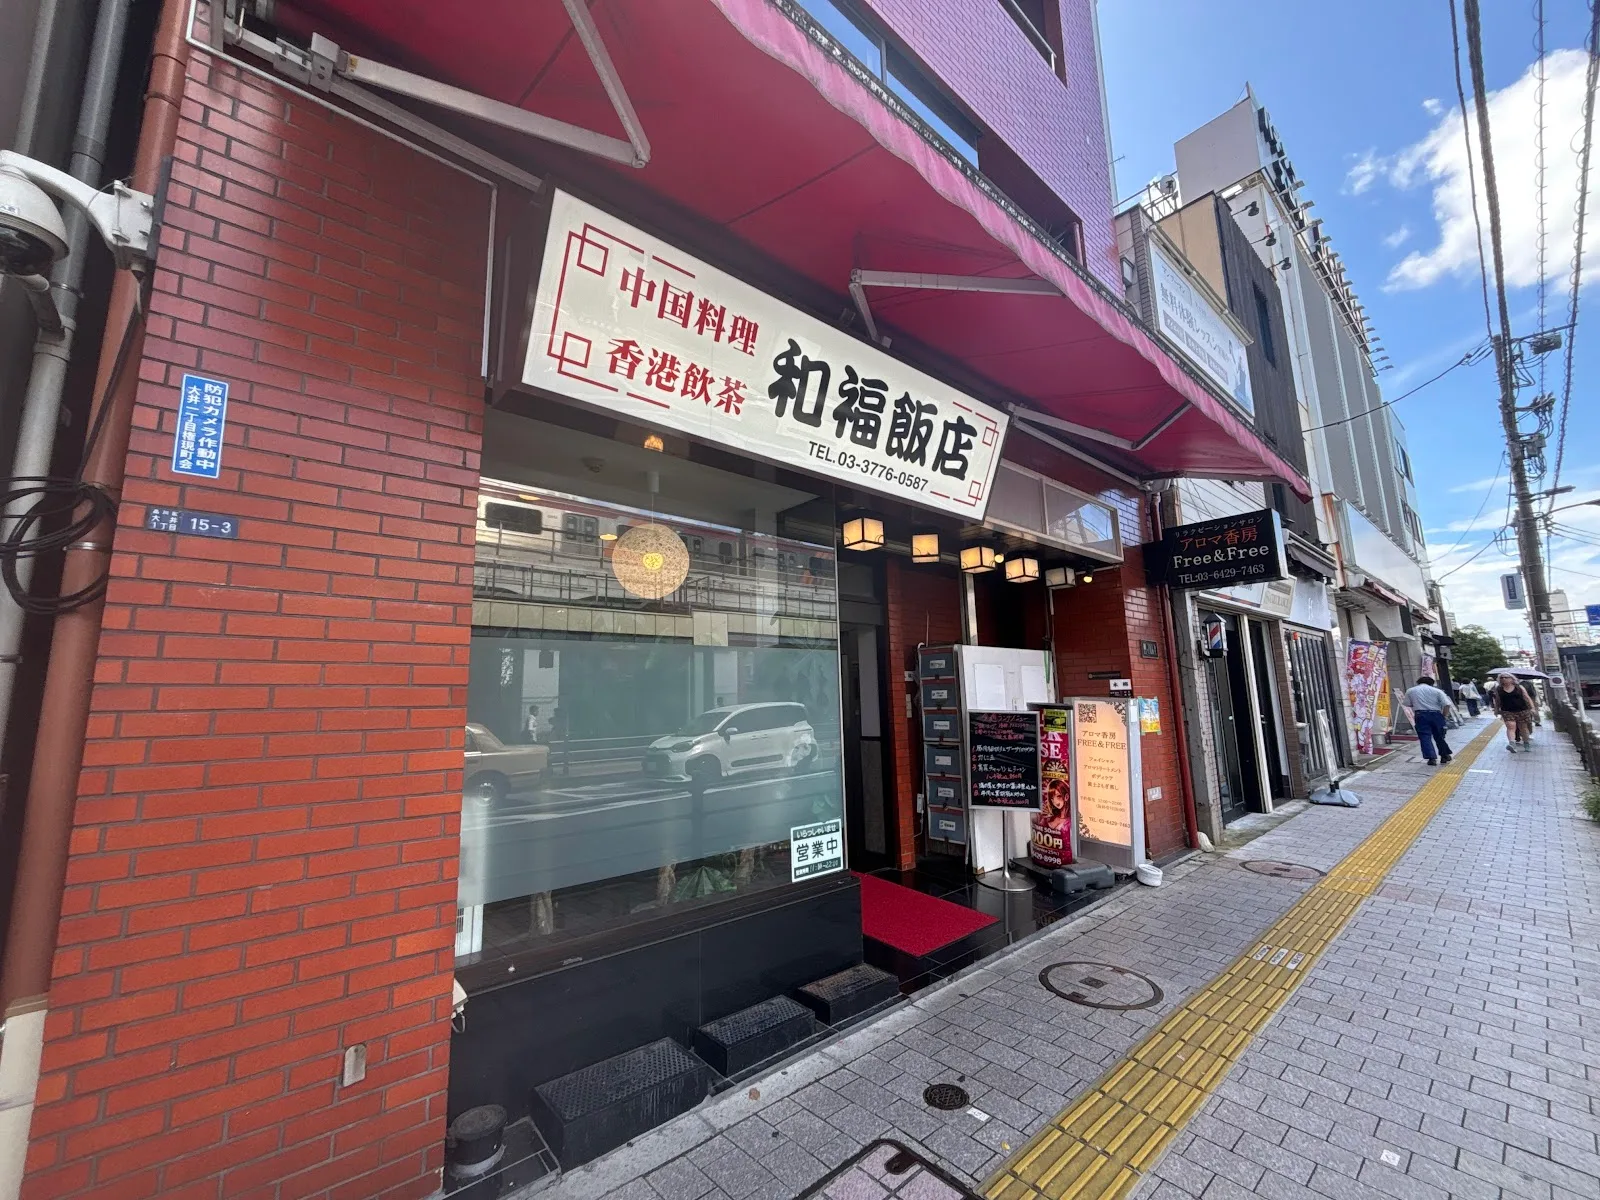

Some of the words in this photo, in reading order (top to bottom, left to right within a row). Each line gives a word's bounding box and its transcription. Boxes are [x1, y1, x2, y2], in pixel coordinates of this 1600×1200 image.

[619, 265, 760, 358] 中国料理
[605, 337, 748, 416] 香港飲茶
[767, 337, 979, 482] 和福飯店
[178, 384, 202, 470] 大井一丁目権現町会
[196, 382, 223, 470] 防犯カメラ作動中
[151, 514, 178, 524] 大井
[152, 521, 177, 531] 1丁目
[190, 517, 232, 534] 15-3
[1175, 516, 1264, 539] リラクゼーションサロン
[1180, 524, 1259, 551] アロマ香房
[1173, 545, 1270, 569] Free&Free
[1081, 730, 1116, 740] アロマ香房
[1083, 764, 1122, 774] アロマトリートメント
[1088, 756, 1115, 764] フェイシャル
[1091, 773, 1114, 781] ボディケア
[796, 824, 837, 839] いらっしゃいませ
[796, 836, 838, 863] 営業中
